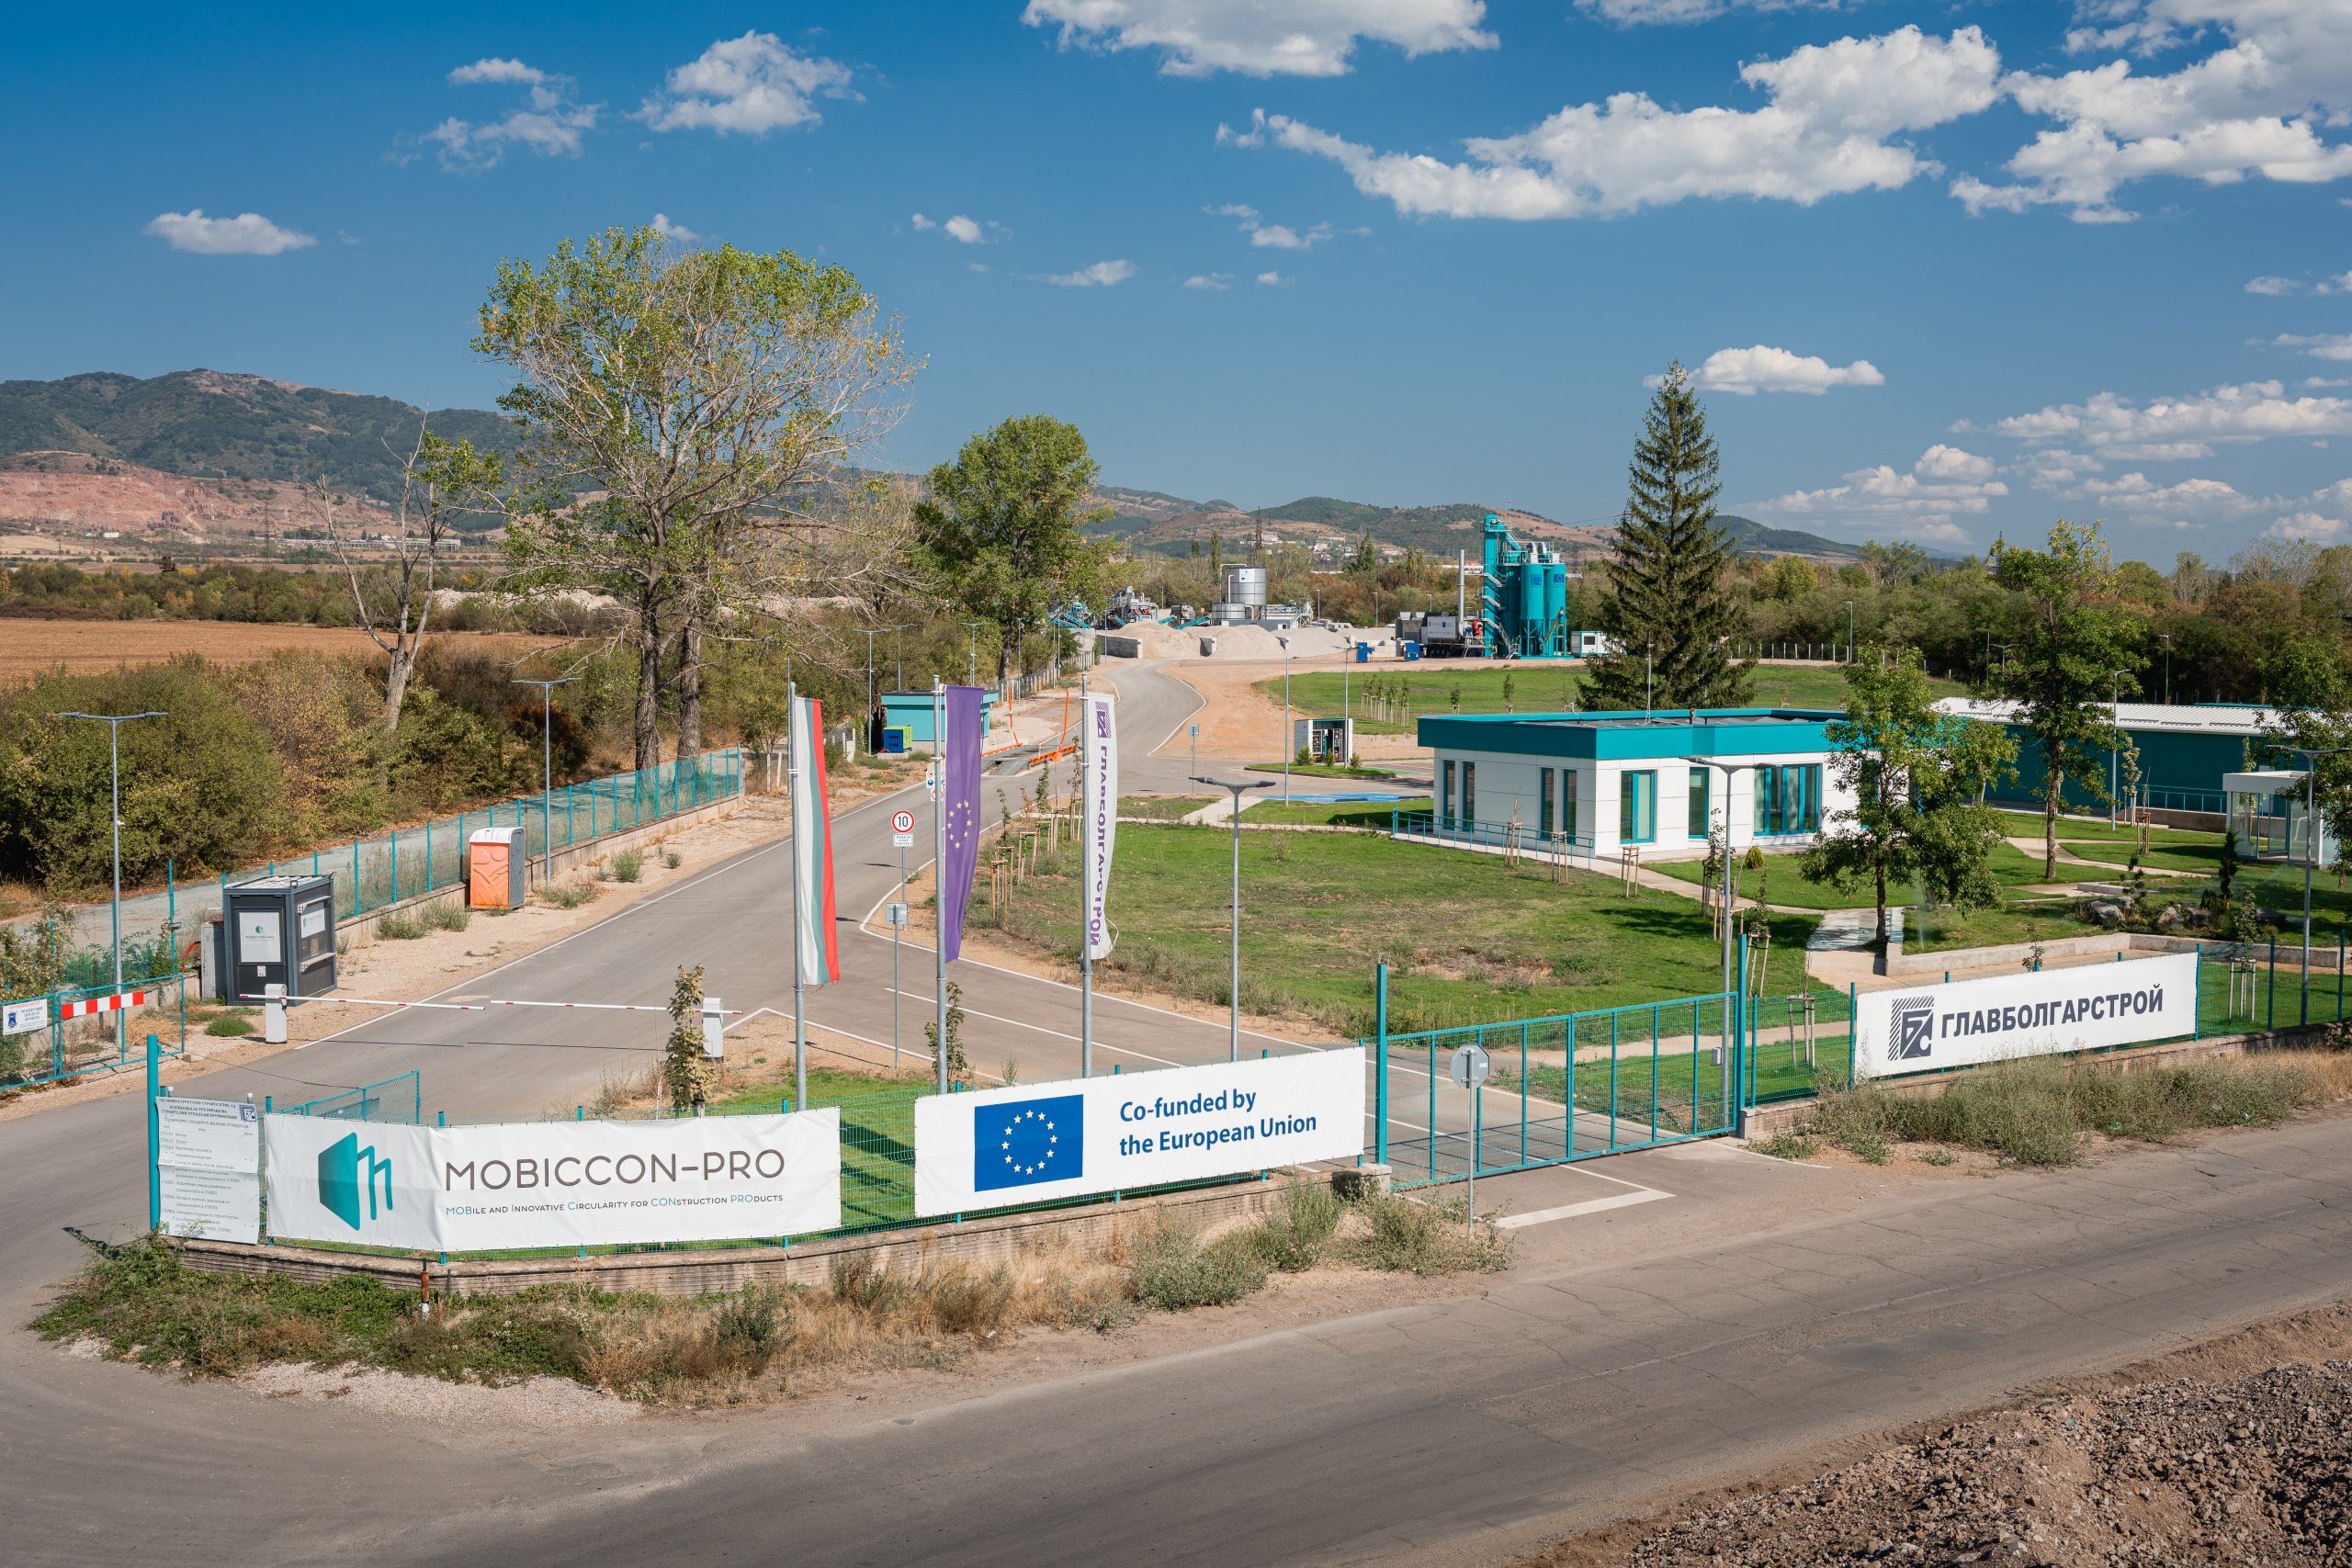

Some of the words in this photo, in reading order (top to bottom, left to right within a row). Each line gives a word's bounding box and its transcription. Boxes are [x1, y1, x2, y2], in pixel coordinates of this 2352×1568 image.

[898, 816, 909, 828] 10
[1941, 984, 2164, 1039] ГЛАВБОЛГАРСТРОЙ
[1119, 1089, 1227, 1122] Co-funded
[1232, 1088, 1257, 1112] by
[1119, 1134, 1154, 1156] the
[1159, 1124, 1255, 1150] European
[1260, 1114, 1317, 1137] Union
[446, 1149, 785, 1191] MOBICCON-PRO
